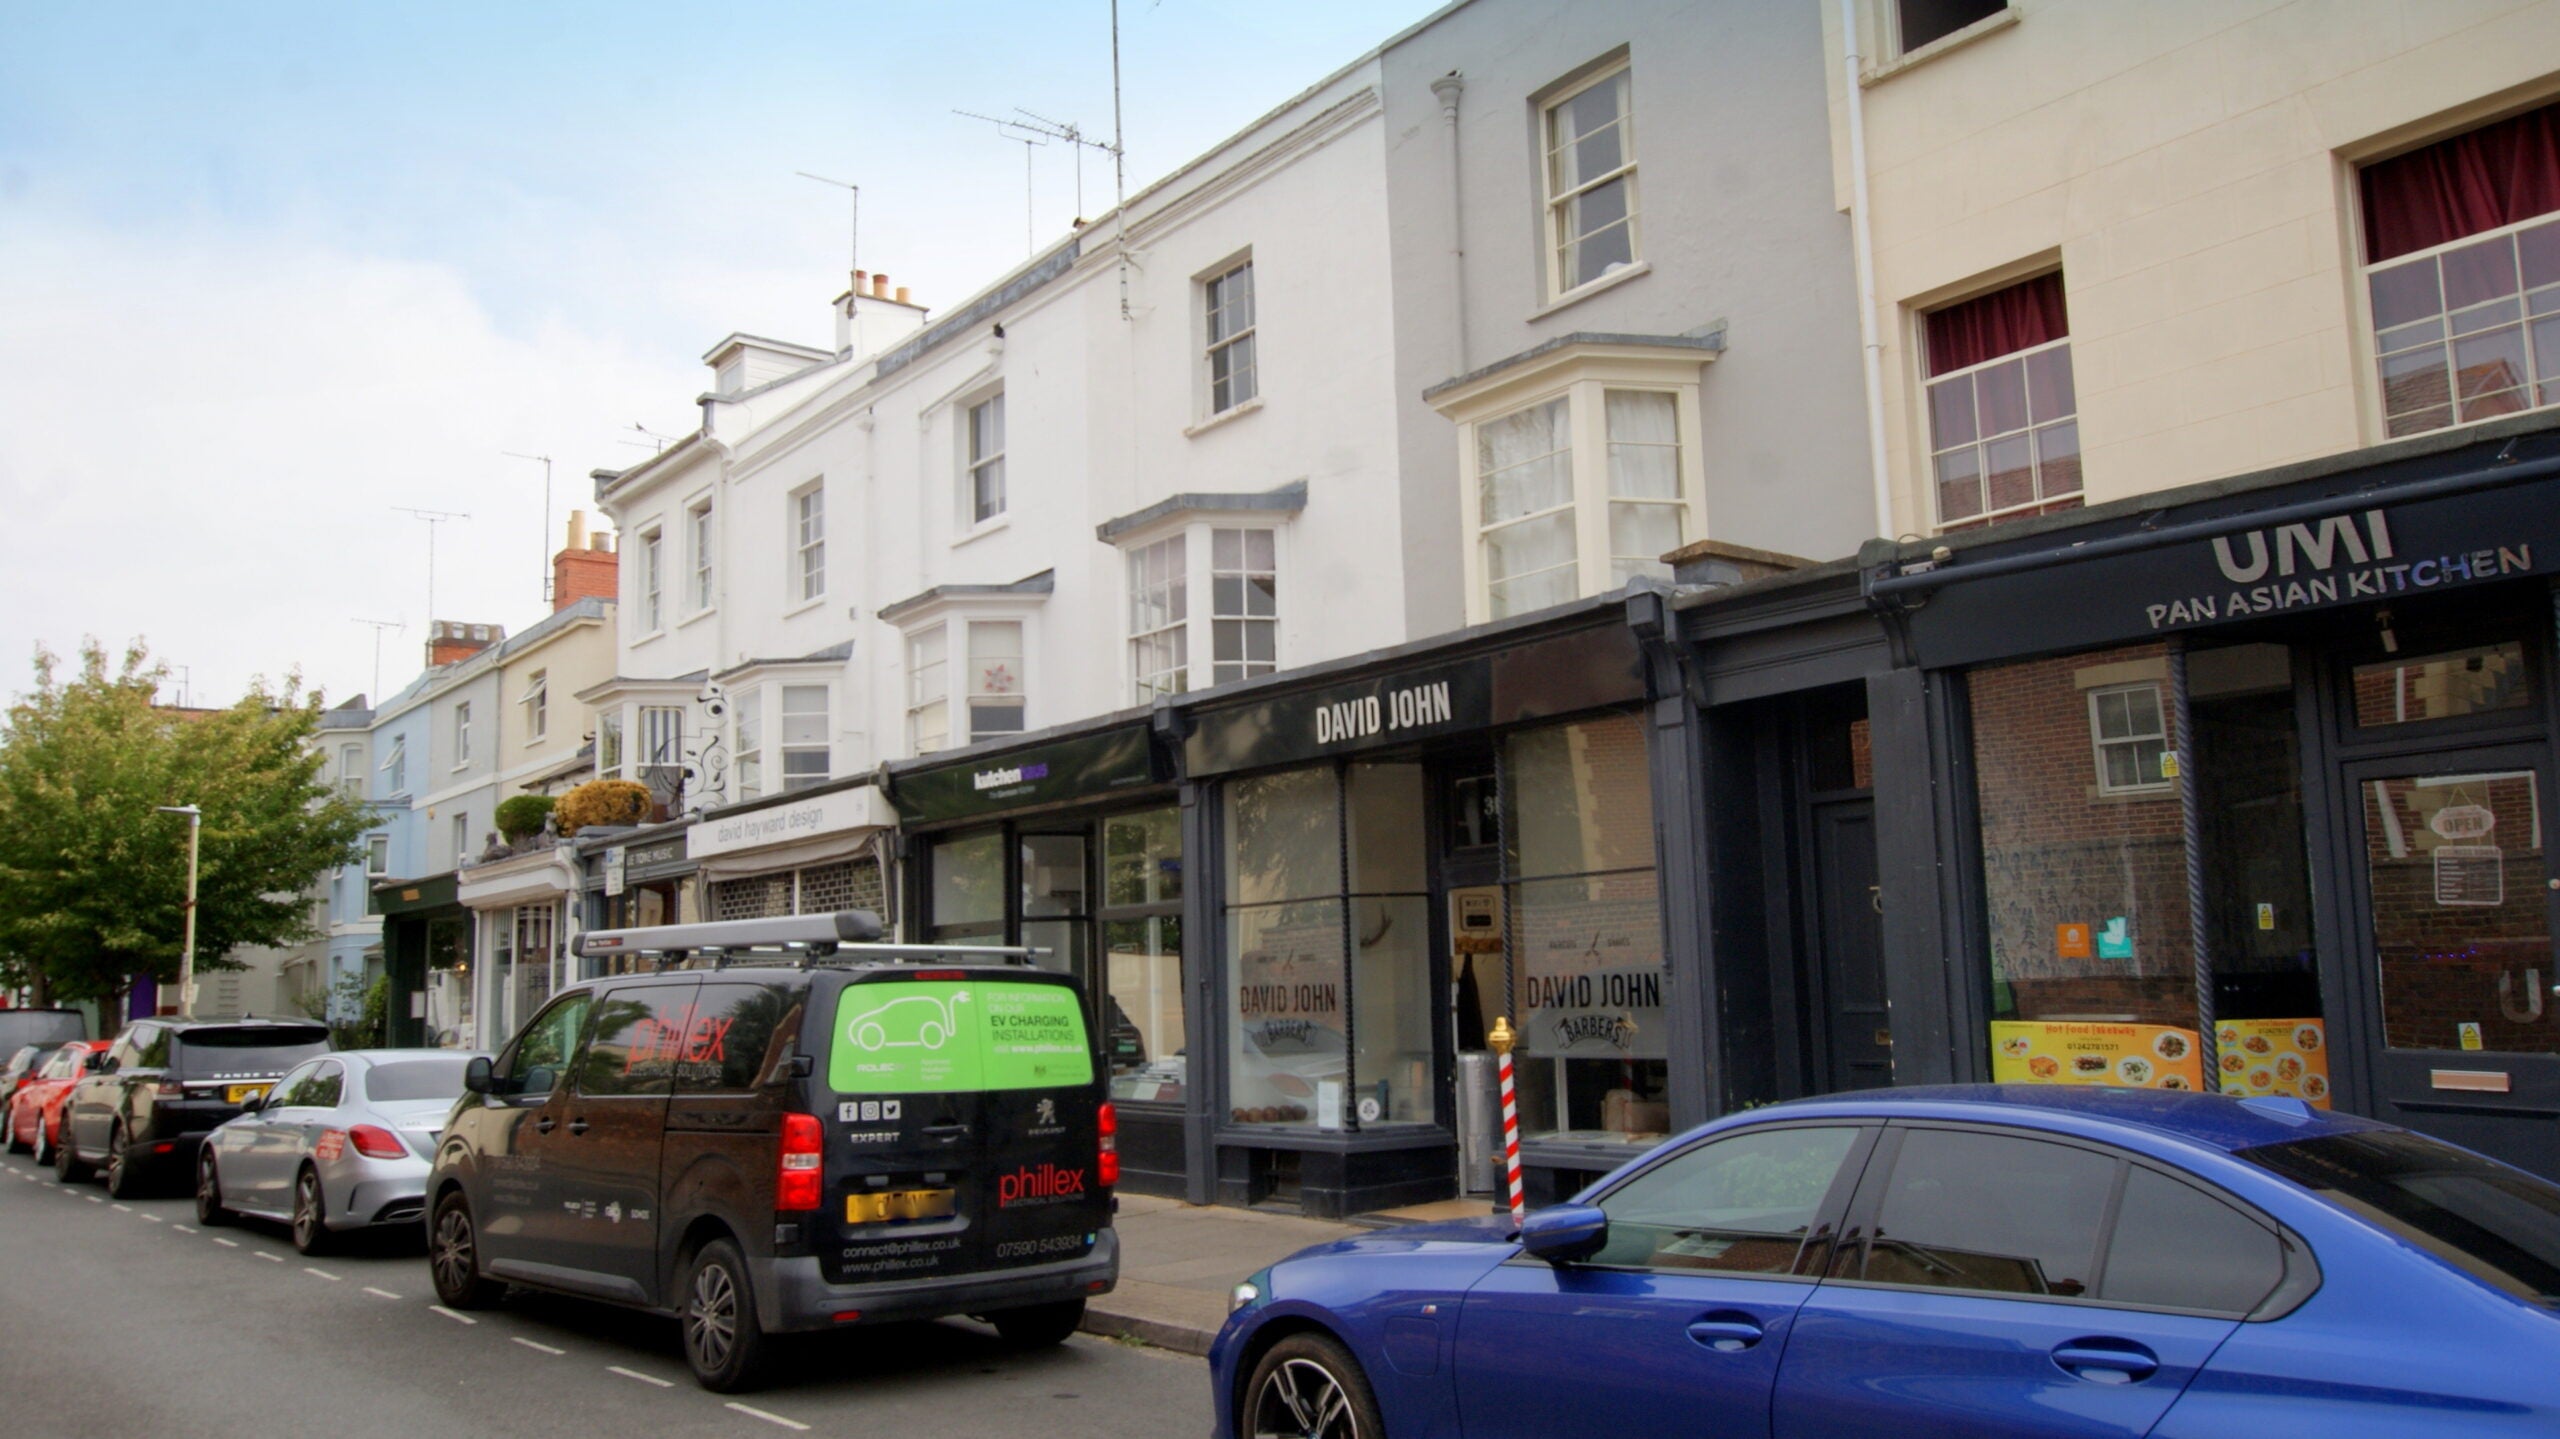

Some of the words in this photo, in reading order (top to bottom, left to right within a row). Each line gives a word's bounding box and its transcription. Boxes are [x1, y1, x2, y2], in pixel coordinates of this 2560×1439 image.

[2211, 509, 2394, 583] UMI
[2147, 594, 2217, 629] PAN
[2227, 576, 2339, 617] ASIAN
[2349, 543, 2533, 598] KITCHEN
[1316, 696, 1381, 744] DAVID
[1389, 681, 1451, 730] JOHN
[718, 824, 743, 843] david
[744, 811, 787, 841] hayward
[788, 807, 824, 834] design
[1240, 985, 1287, 1013] DAVID
[1293, 983, 1336, 1012] JOHN
[1527, 975, 1592, 1009] DAVID
[1600, 972, 1660, 1008] JOHN
[990, 1015, 1006, 1027] EV
[1009, 1015, 1069, 1028] CHARGING
[992, 1029, 1075, 1041] INSTALLATIONS
[1564, 1016, 1624, 1043] BARBERS
[2045, 1024, 2063, 1035] Hot
[624, 1002, 734, 1077] phillex
[850, 1131, 900, 1144] EXPERT
[999, 1162, 1085, 1208] phillex
[842, 1237, 961, 1259] connect@phillex.co.uk
[996, 1239, 1037, 1259] 07590
[841, 1254, 941, 1274] www.phillex.co.uk
